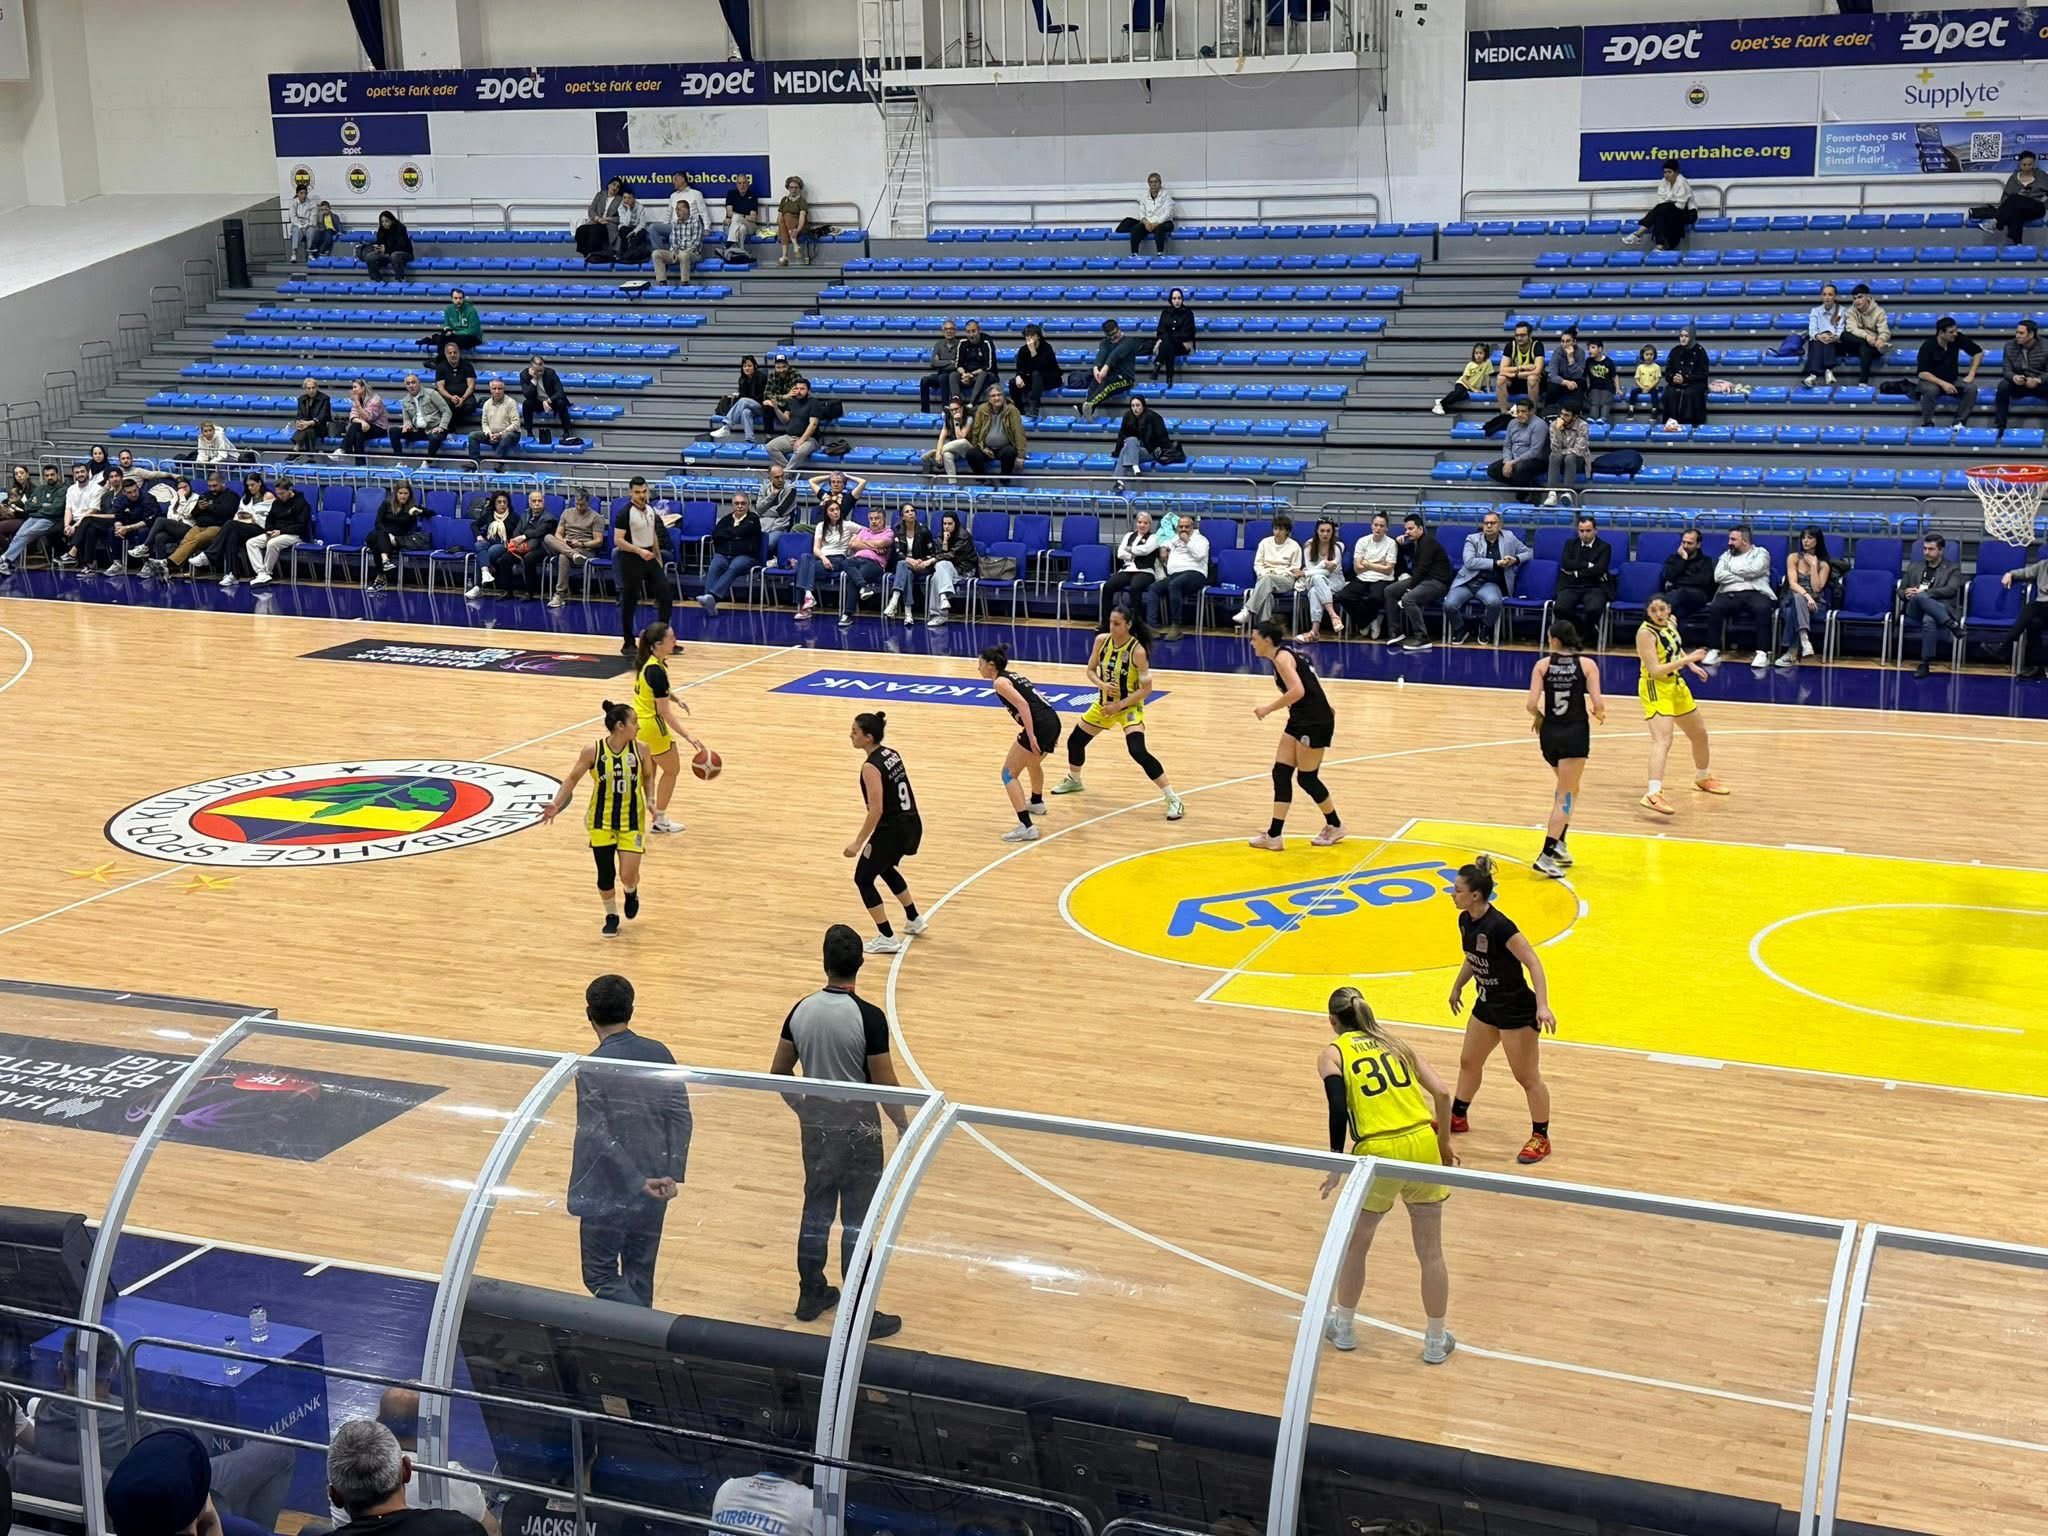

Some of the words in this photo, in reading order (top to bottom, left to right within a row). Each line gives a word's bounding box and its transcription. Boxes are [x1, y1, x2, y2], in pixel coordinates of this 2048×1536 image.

[1602, 29, 1704, 66] opet
[1730, 35, 1791, 52] opet'se
[1795, 33, 1829, 48] fark
[1834, 33, 1873, 47] eder
[1900, 17, 2009, 54] opet
[1475, 44, 1564, 64] MEDICANA
[282, 79, 347, 107] opet
[408, 84, 431, 96] fark
[433, 84, 459, 96] eder
[475, 77, 546, 103] opet
[610, 79, 633, 92] fark
[635, 79, 662, 92] eder
[680, 68, 755, 99] opet
[774, 68, 880, 94] MEDICAN
[1891, 131, 1907, 141] SK
[1599, 144, 1792, 162] www.fenerbahce.org
[808, 677, 1070, 704] HLKBANK
[1552, 691, 1571, 716] 5
[396, 763, 505, 780] 1907
[130, 770, 296, 821] KULÜBÜ
[612, 779, 627, 794] 10
[898, 782, 911, 811] 9
[127, 823, 229, 858] SPOR
[1352, 1052, 1412, 1097] 30
